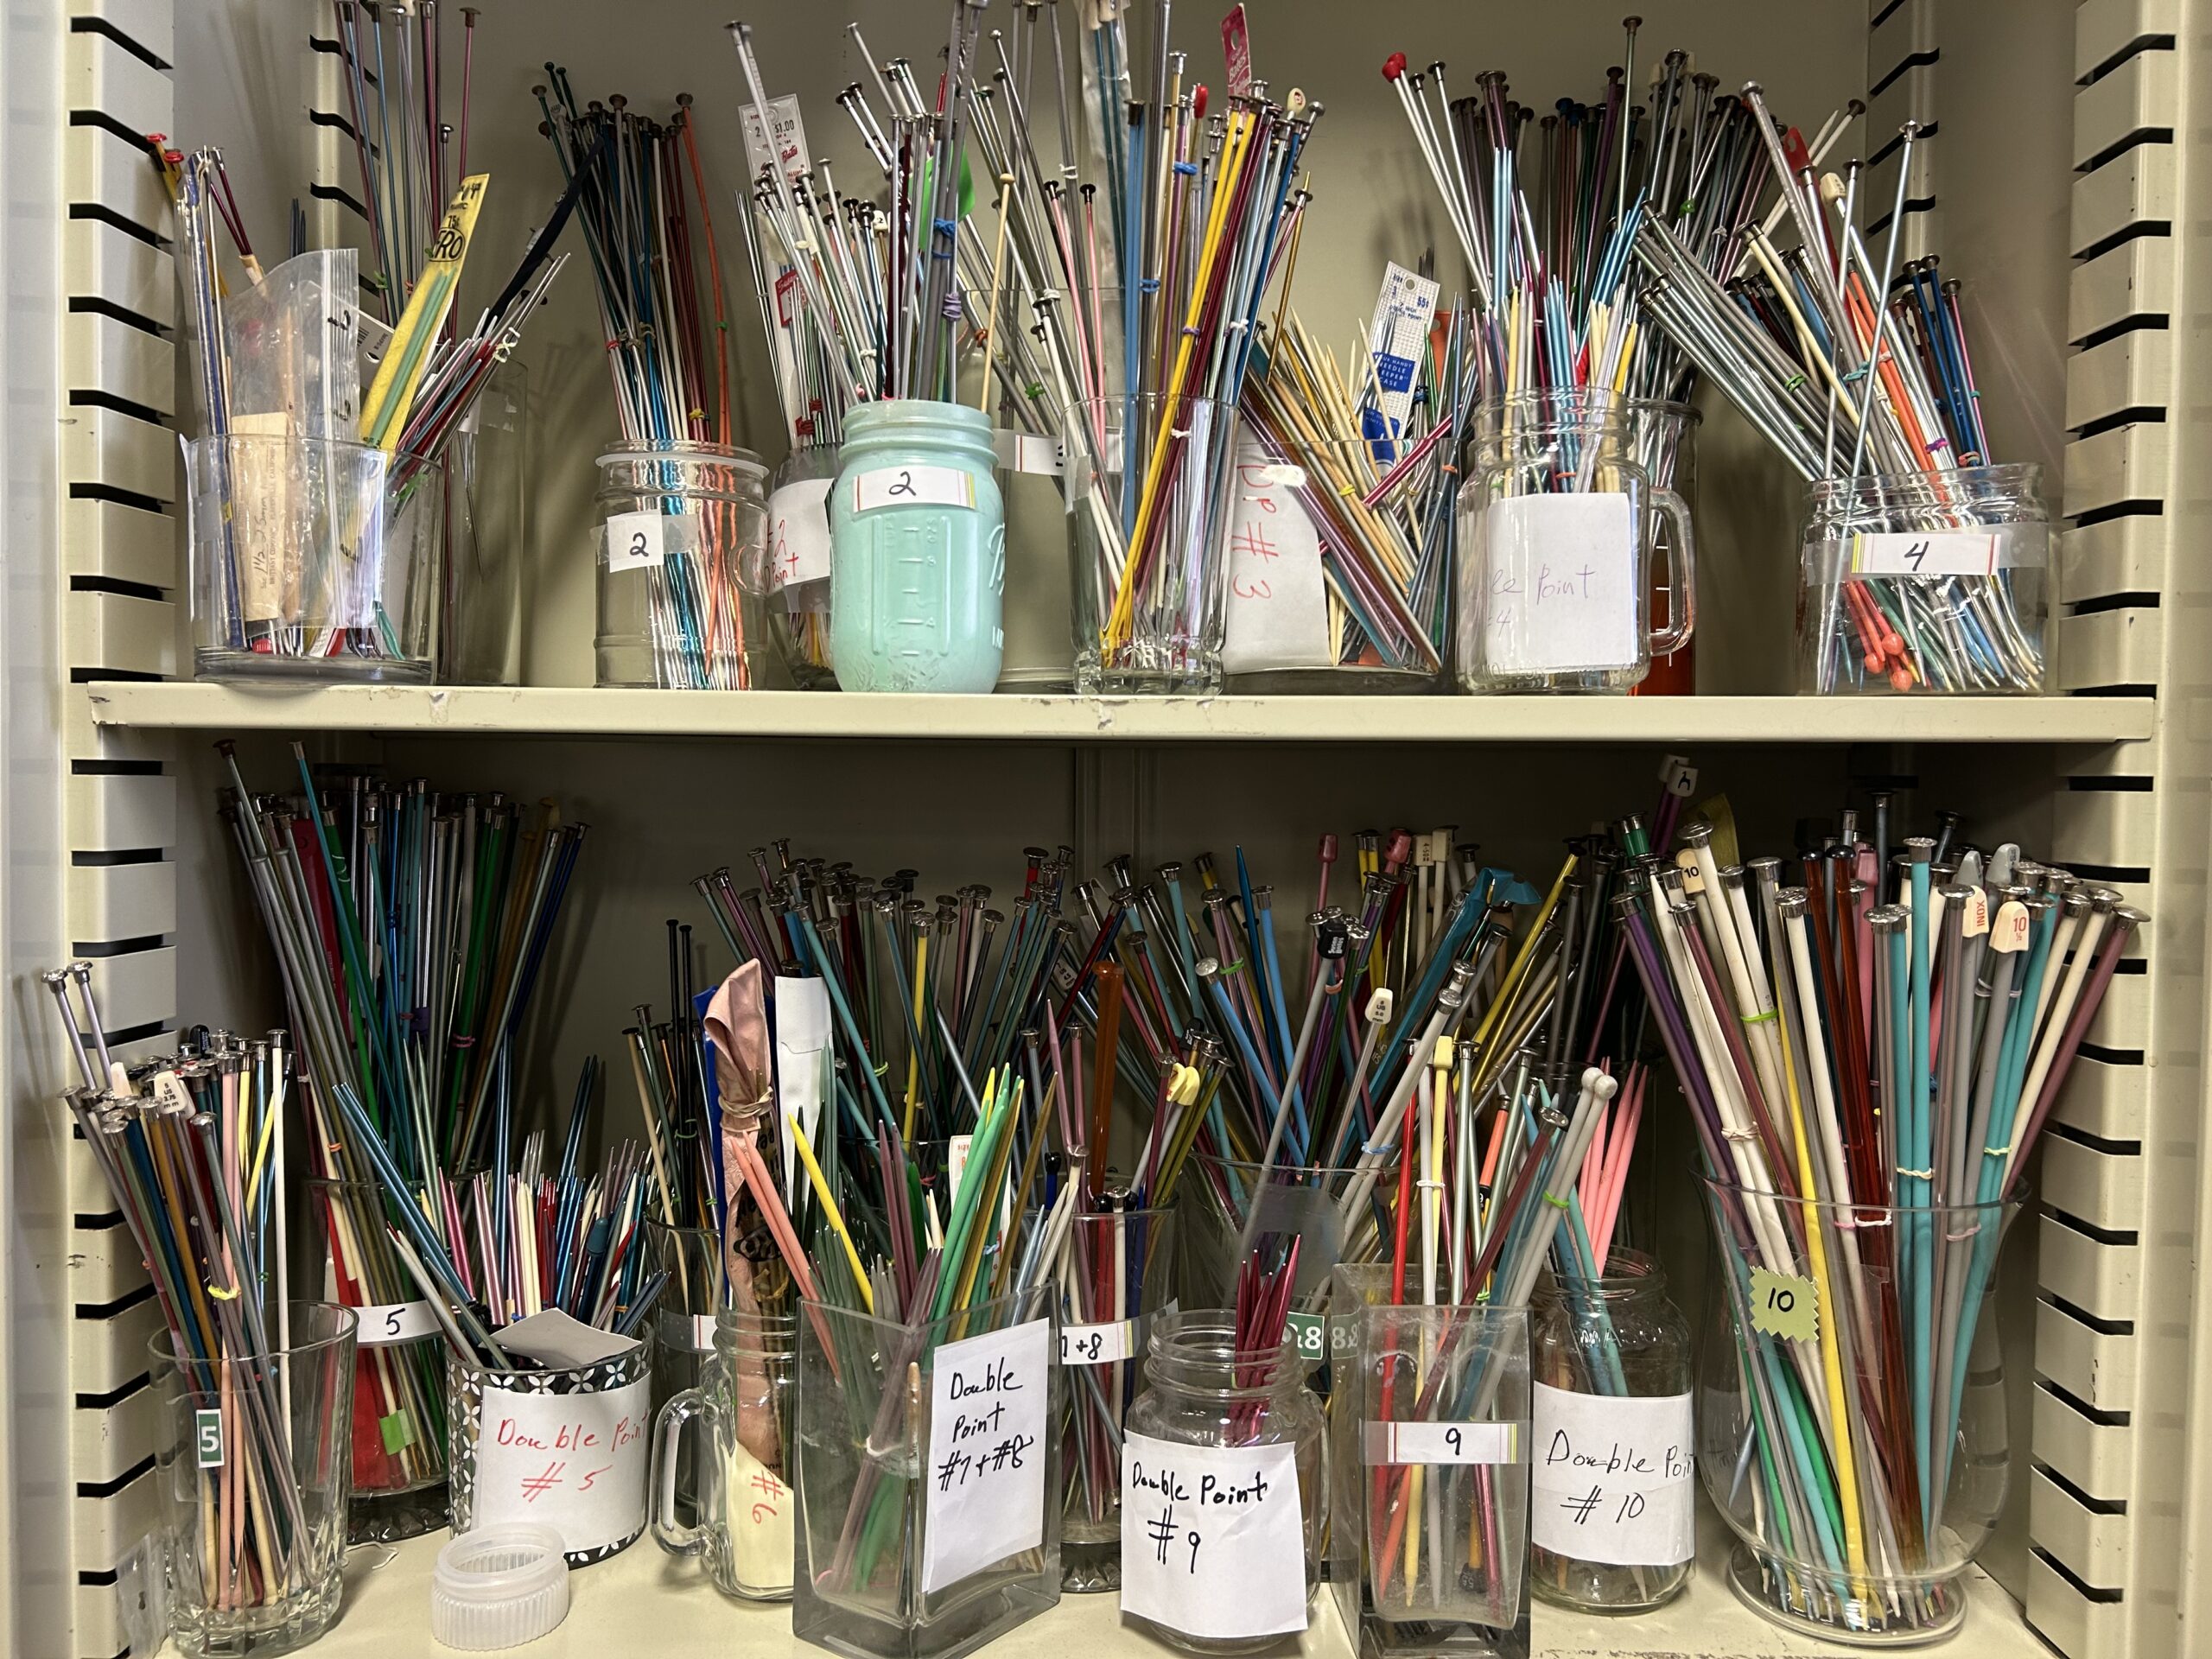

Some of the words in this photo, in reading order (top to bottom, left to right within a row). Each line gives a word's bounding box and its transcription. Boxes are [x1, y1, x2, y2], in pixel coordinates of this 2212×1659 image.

[754, 126, 761, 137] 2
[774, 119, 795, 134] $1.00
[781, 144, 798, 164] Bates
[1392, 359, 1413, 369] HANDY
[888, 471, 917, 497] 2
[629, 531, 650, 557] 2
[1904, 541, 1929, 572] 4
[1536, 563, 1596, 606] Point
[1684, 866, 1700, 879] 10
[1976, 900, 1986, 927] INOX
[2013, 916, 2027, 932] 10
[1768, 1287, 1795, 1313] 10
[385, 1307, 406, 1336] 5
[950, 1357, 1023, 1400] Double
[497, 1418, 600, 1452] Double
[952, 1401, 1006, 1443] Point
[200, 1426, 219, 1452] 5
[1445, 1427, 1461, 1456] 9
[1546, 1429, 1655, 1474] Double
[1665, 1445, 1694, 1478] Poin
[1133, 1461, 1190, 1502] Double
[1200, 1471, 1268, 1505] Point
